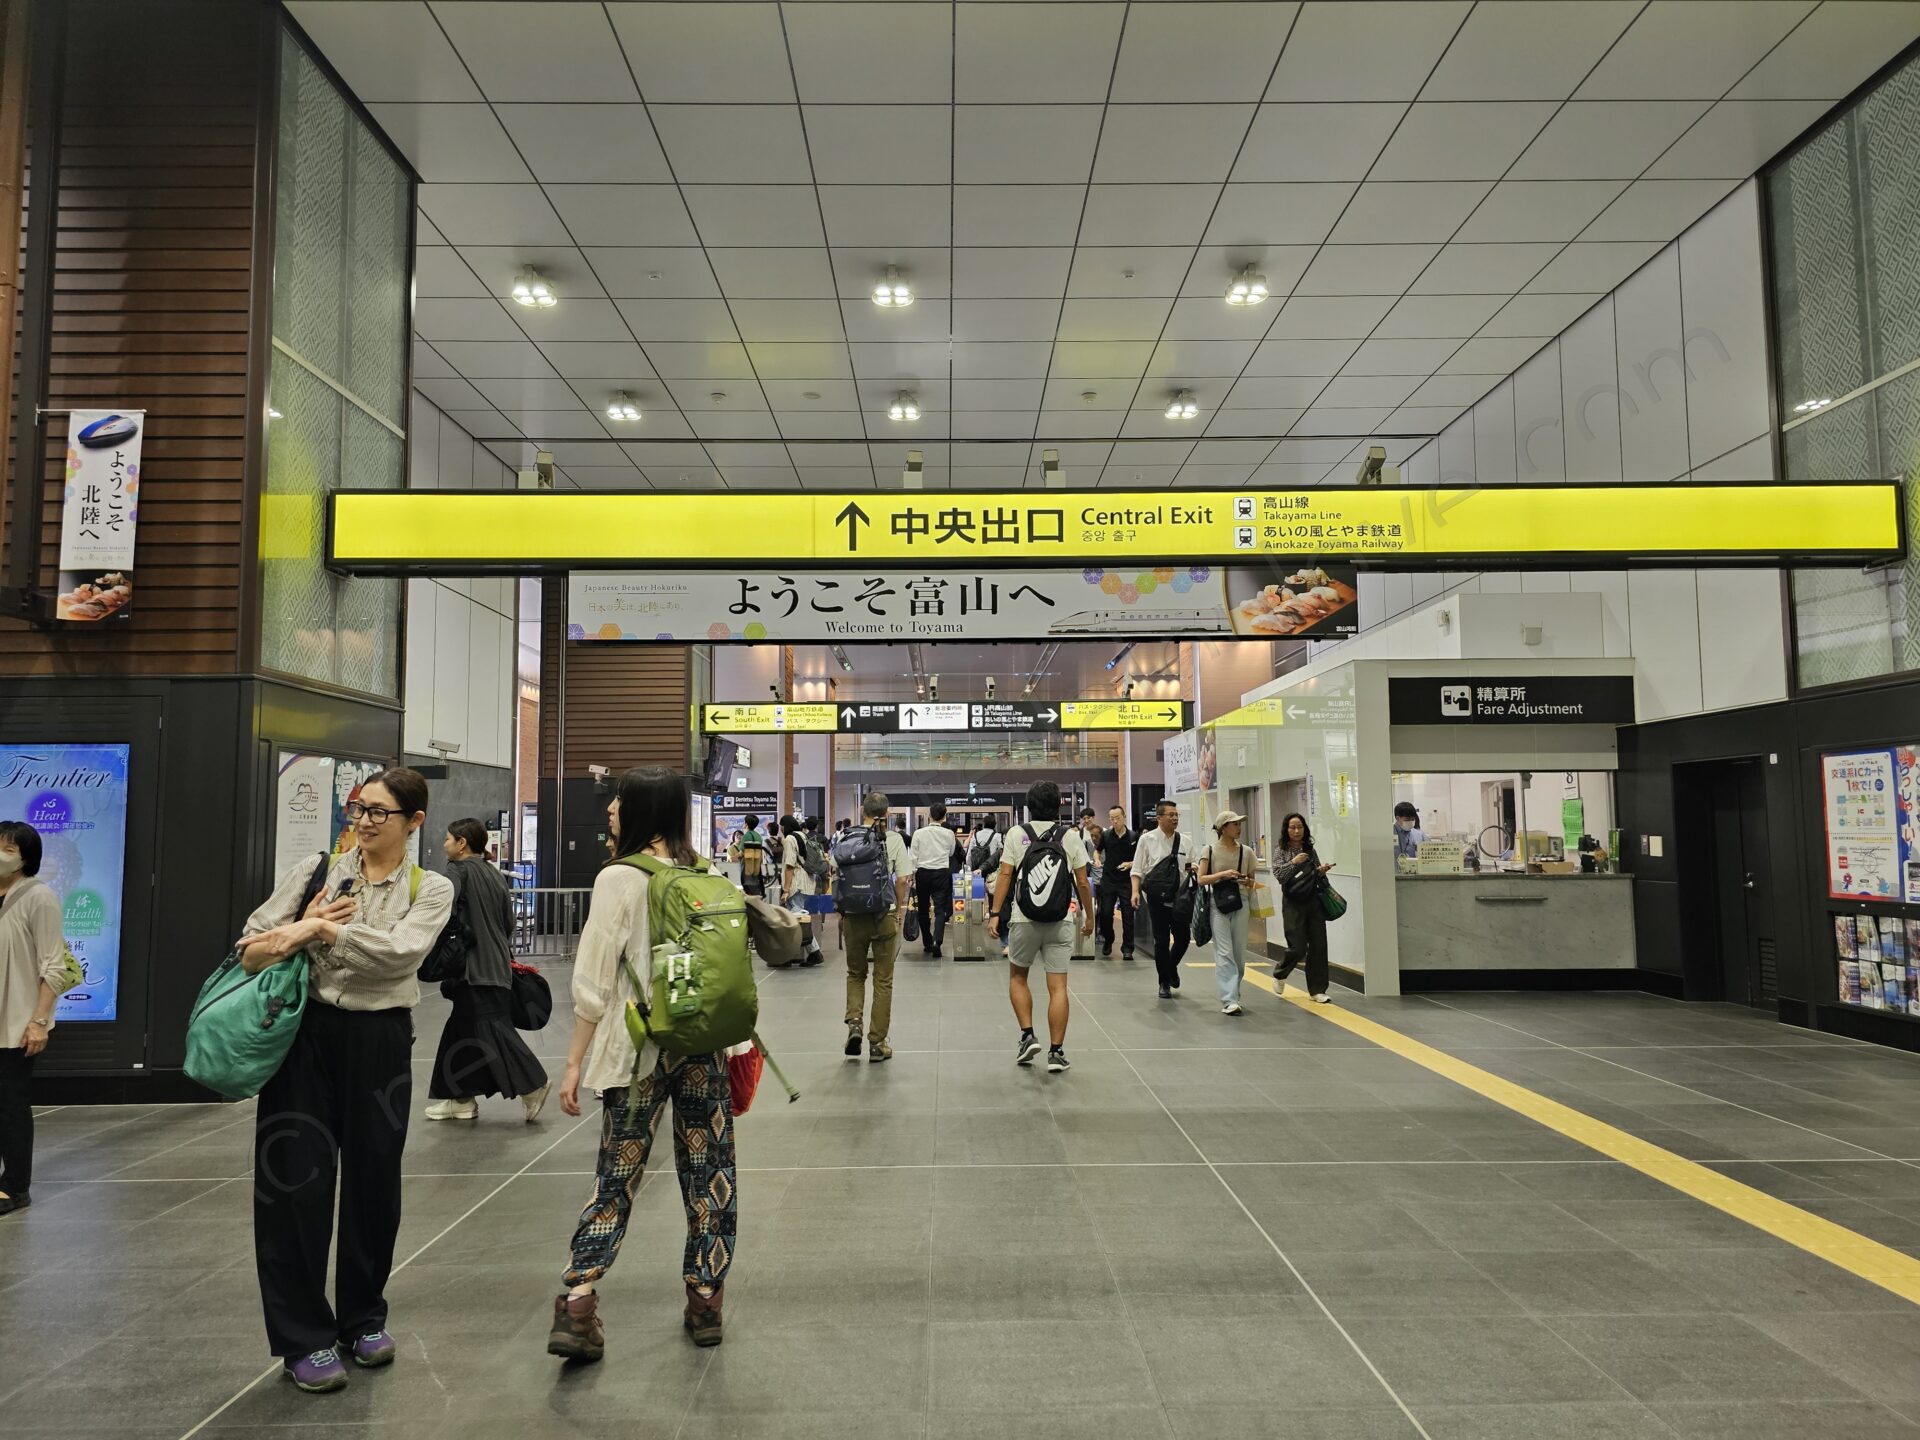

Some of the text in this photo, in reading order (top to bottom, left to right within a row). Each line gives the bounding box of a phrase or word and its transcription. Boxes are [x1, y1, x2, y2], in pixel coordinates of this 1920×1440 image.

[106, 450, 125, 532] ようこそ
[1263, 496, 1309, 509] 高山線
[80, 484, 101, 540] 北陸へ
[1080, 505, 1213, 527] Central Exit
[1263, 510, 1342, 522] Takayama Line
[890, 506, 1066, 545] 中央出口
[1263, 524, 1403, 538] あいの風とやま鉄道
[1081, 529, 1137, 543] 중앙 출구
[1264, 539, 1404, 552] Ainokaze Toyama Railway
[728, 575, 1055, 618] ようこそ富山へ
[825, 620, 964, 637] Welcome to Toyama
[1476, 686, 1526, 702] 精算所
[1477, 702, 1583, 718] Fare Adjustment
[0, 752, 112, 790] Frontier
[1831, 765, 1884, 779] 交通系ICカード
[33, 810, 66, 821] Heart
[1027, 854, 1054, 893] NIKE
[64, 908, 101, 919] Health
